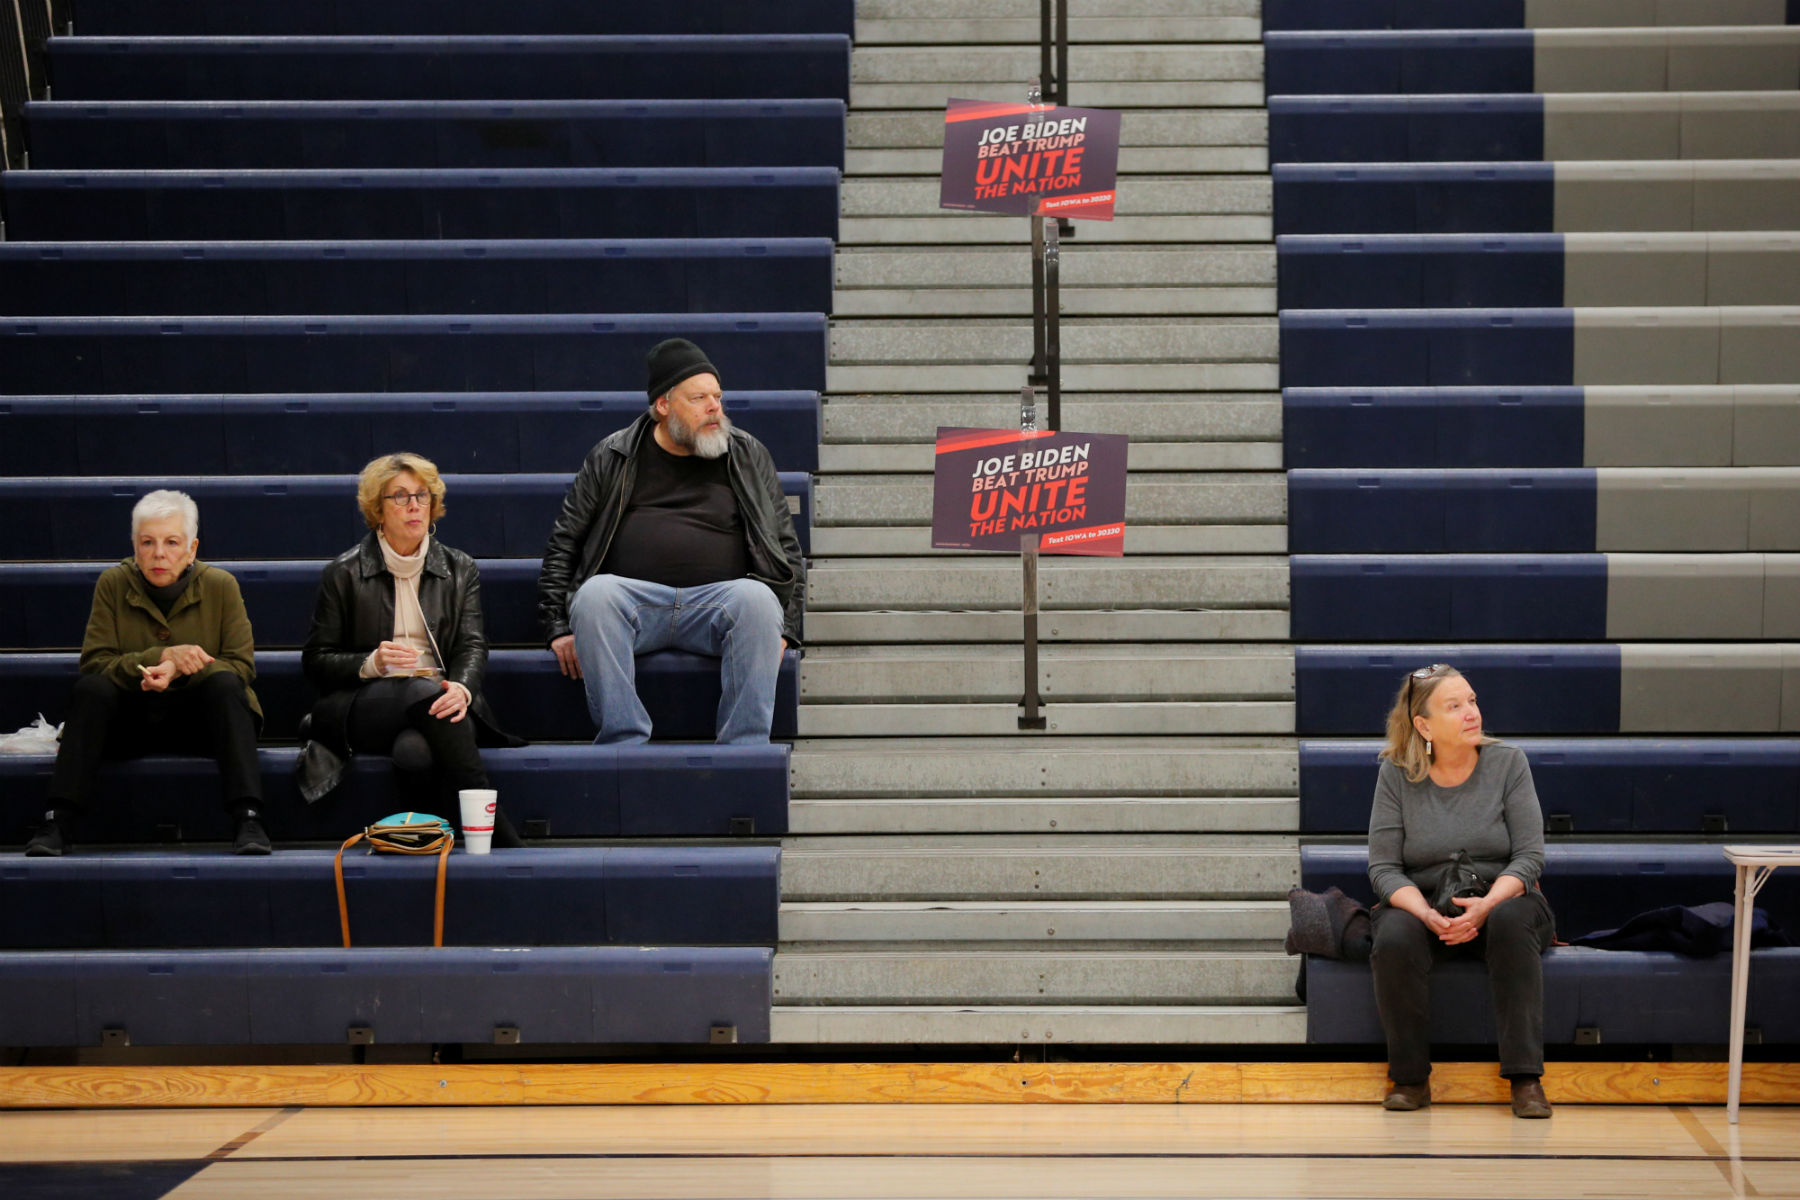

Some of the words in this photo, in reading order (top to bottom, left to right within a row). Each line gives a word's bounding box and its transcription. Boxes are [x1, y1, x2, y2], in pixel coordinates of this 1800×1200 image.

[977, 141, 1022, 159] BEAT
[1026, 133, 1085, 152] TRUMP
[978, 125, 1019, 146] JOE
[1022, 117, 1087, 140] BIDEN
[975, 147, 1085, 185] UNITE
[974, 183, 1008, 199] THE
[1012, 174, 1082, 195] NATION
[972, 455, 1015, 478] JOE
[1020, 443, 1090, 470] BIDEN
[972, 472, 1020, 492] BEAT
[1025, 461, 1089, 484] TRUMP
[970, 476, 1089, 522] UNITE
[969, 518, 1006, 537] THE
[1011, 505, 1087, 531] NATION
[1048, 536, 1064, 544] Text
[1065, 533, 1087, 542] IOWA
